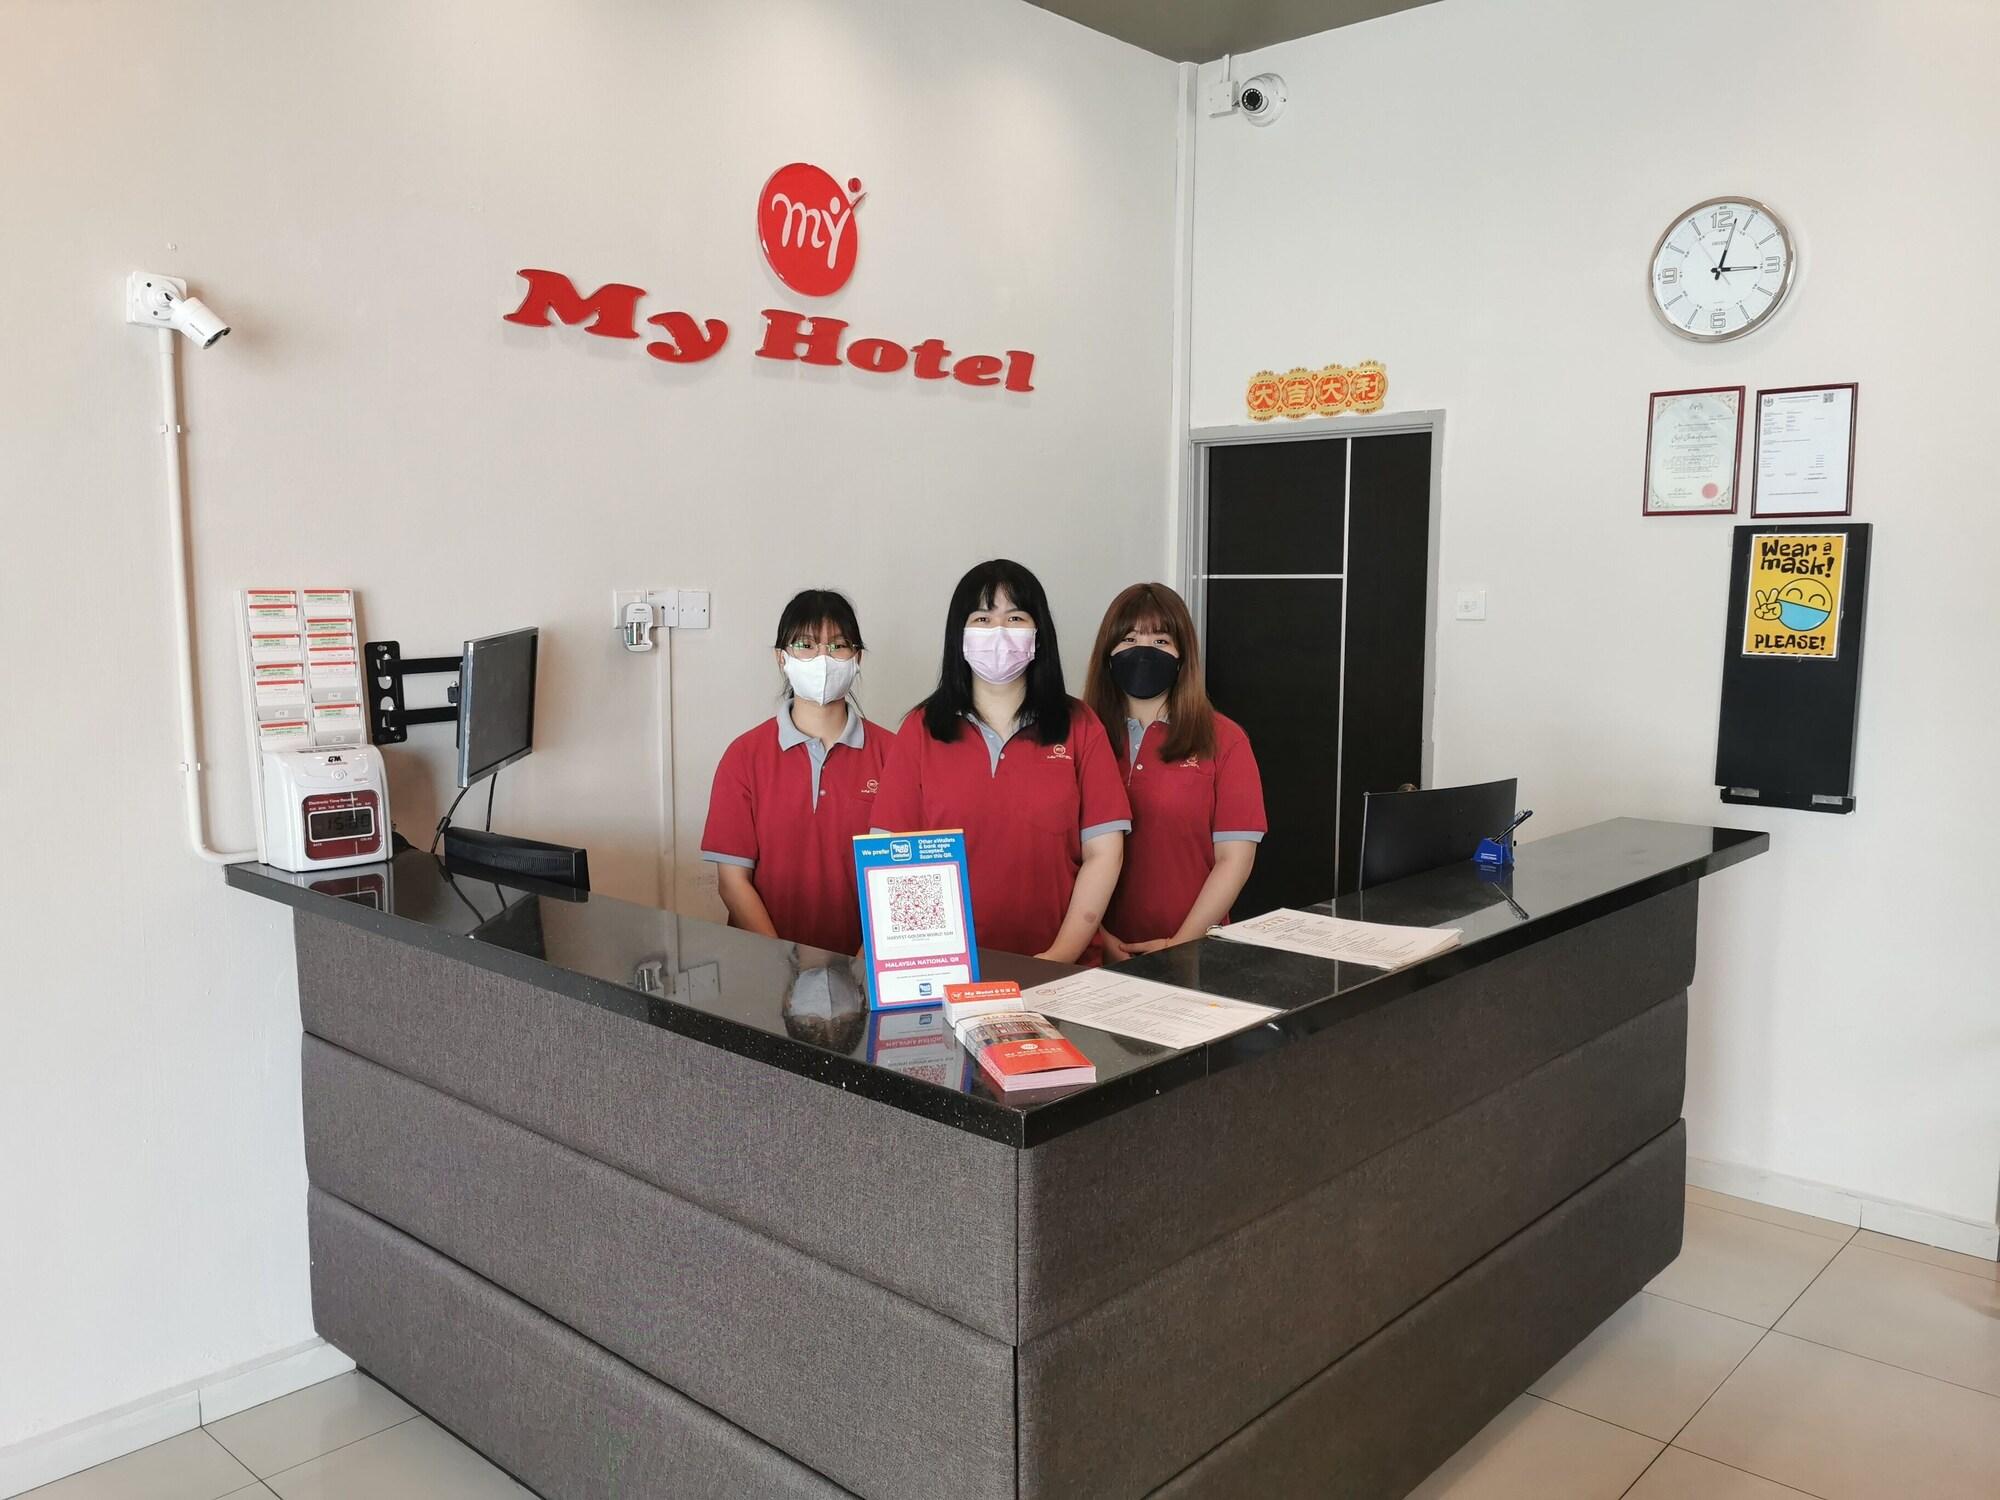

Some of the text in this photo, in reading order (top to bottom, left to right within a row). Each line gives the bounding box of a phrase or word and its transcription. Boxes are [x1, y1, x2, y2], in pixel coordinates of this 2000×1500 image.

[1711, 211, 1733, 228] 12
[1662, 255, 1781, 285] 9 3
[1711, 311, 1726, 329] 6
[503, 268, 1035, 393] My Hotel
[1251, 372, 1381, 408] 大吉大利
[1761, 539, 1832, 558] Wear a
[1760, 556, 1835, 578] mask!
[1754, 633, 1826, 651] PLEASE!
[885, 960, 917, 969] MALAYSIA
[917, 957, 949, 966] NATIONAL
